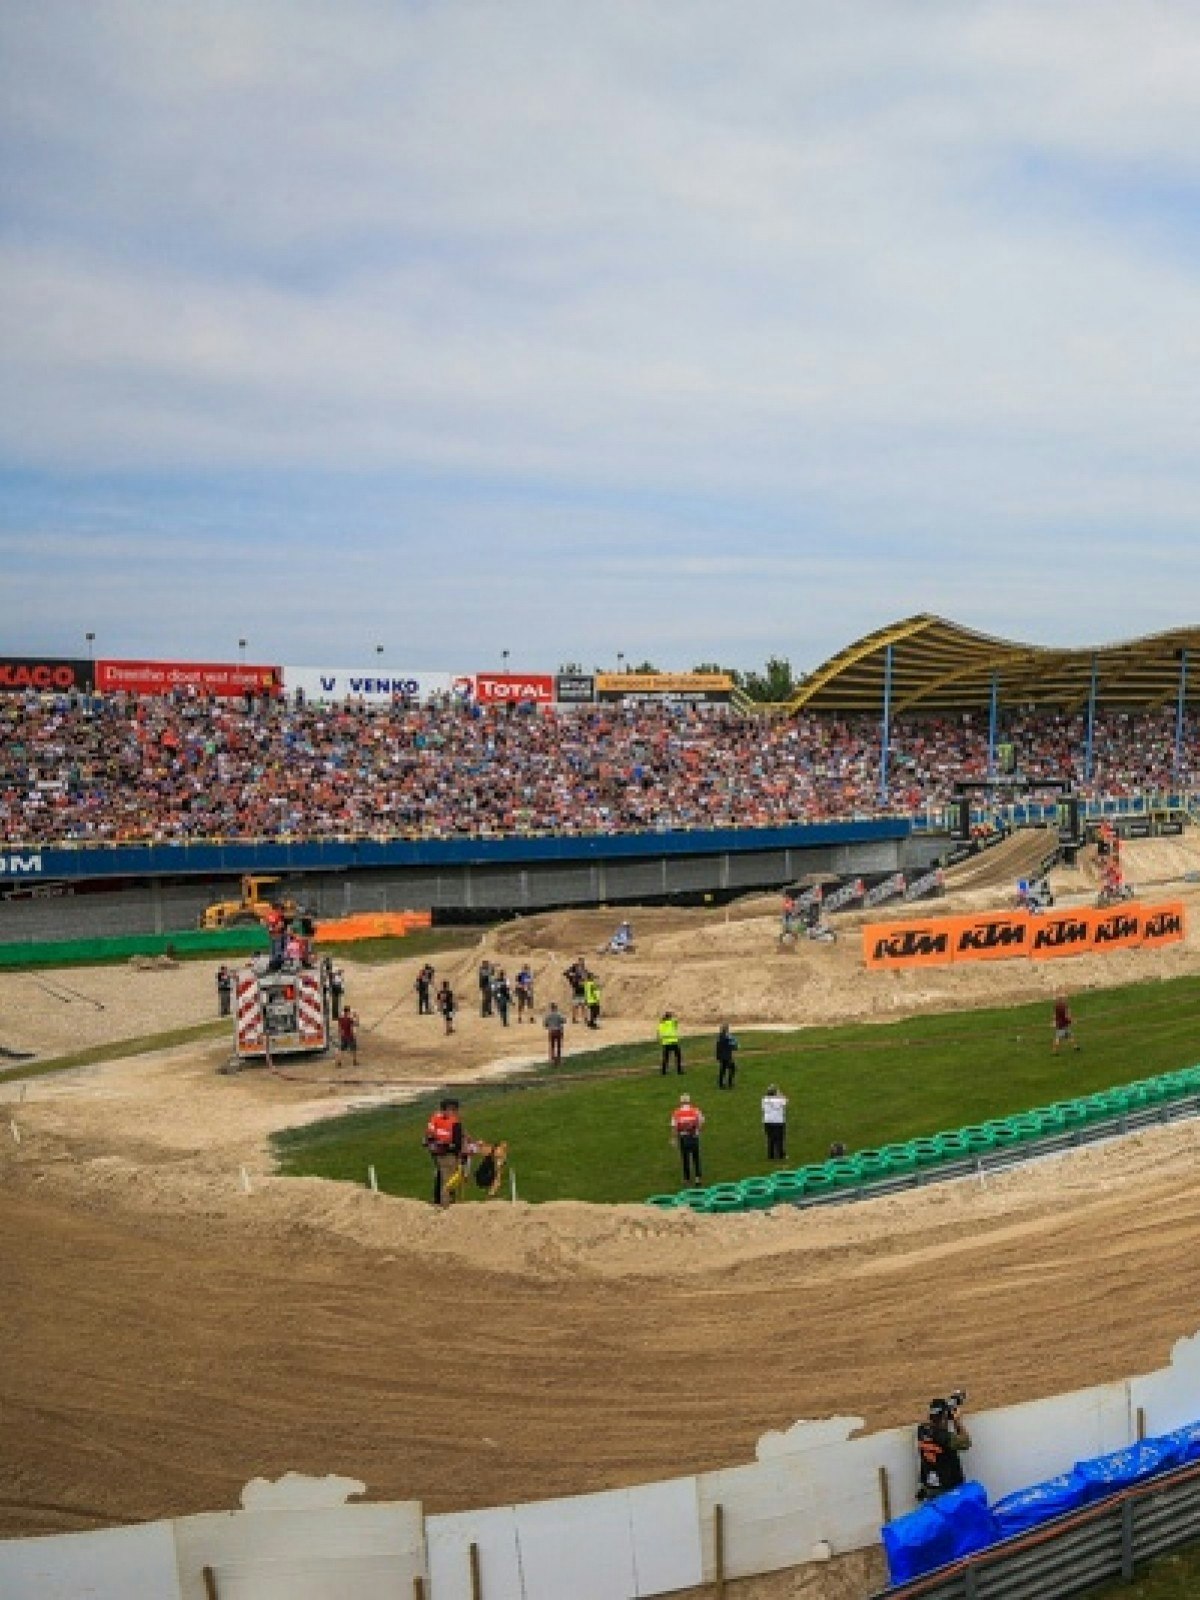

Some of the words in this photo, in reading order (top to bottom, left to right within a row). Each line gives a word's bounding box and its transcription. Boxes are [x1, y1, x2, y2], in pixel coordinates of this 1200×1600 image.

[350, 678, 419, 694] VENKO
[481, 680, 551, 698] TOTAL
[872, 930, 948, 959] KTM
[957, 921, 1026, 949] KTM
[1033, 918, 1087, 949] KTM
[1094, 914, 1138, 943] KTM
[1143, 911, 1180, 939] KTM
